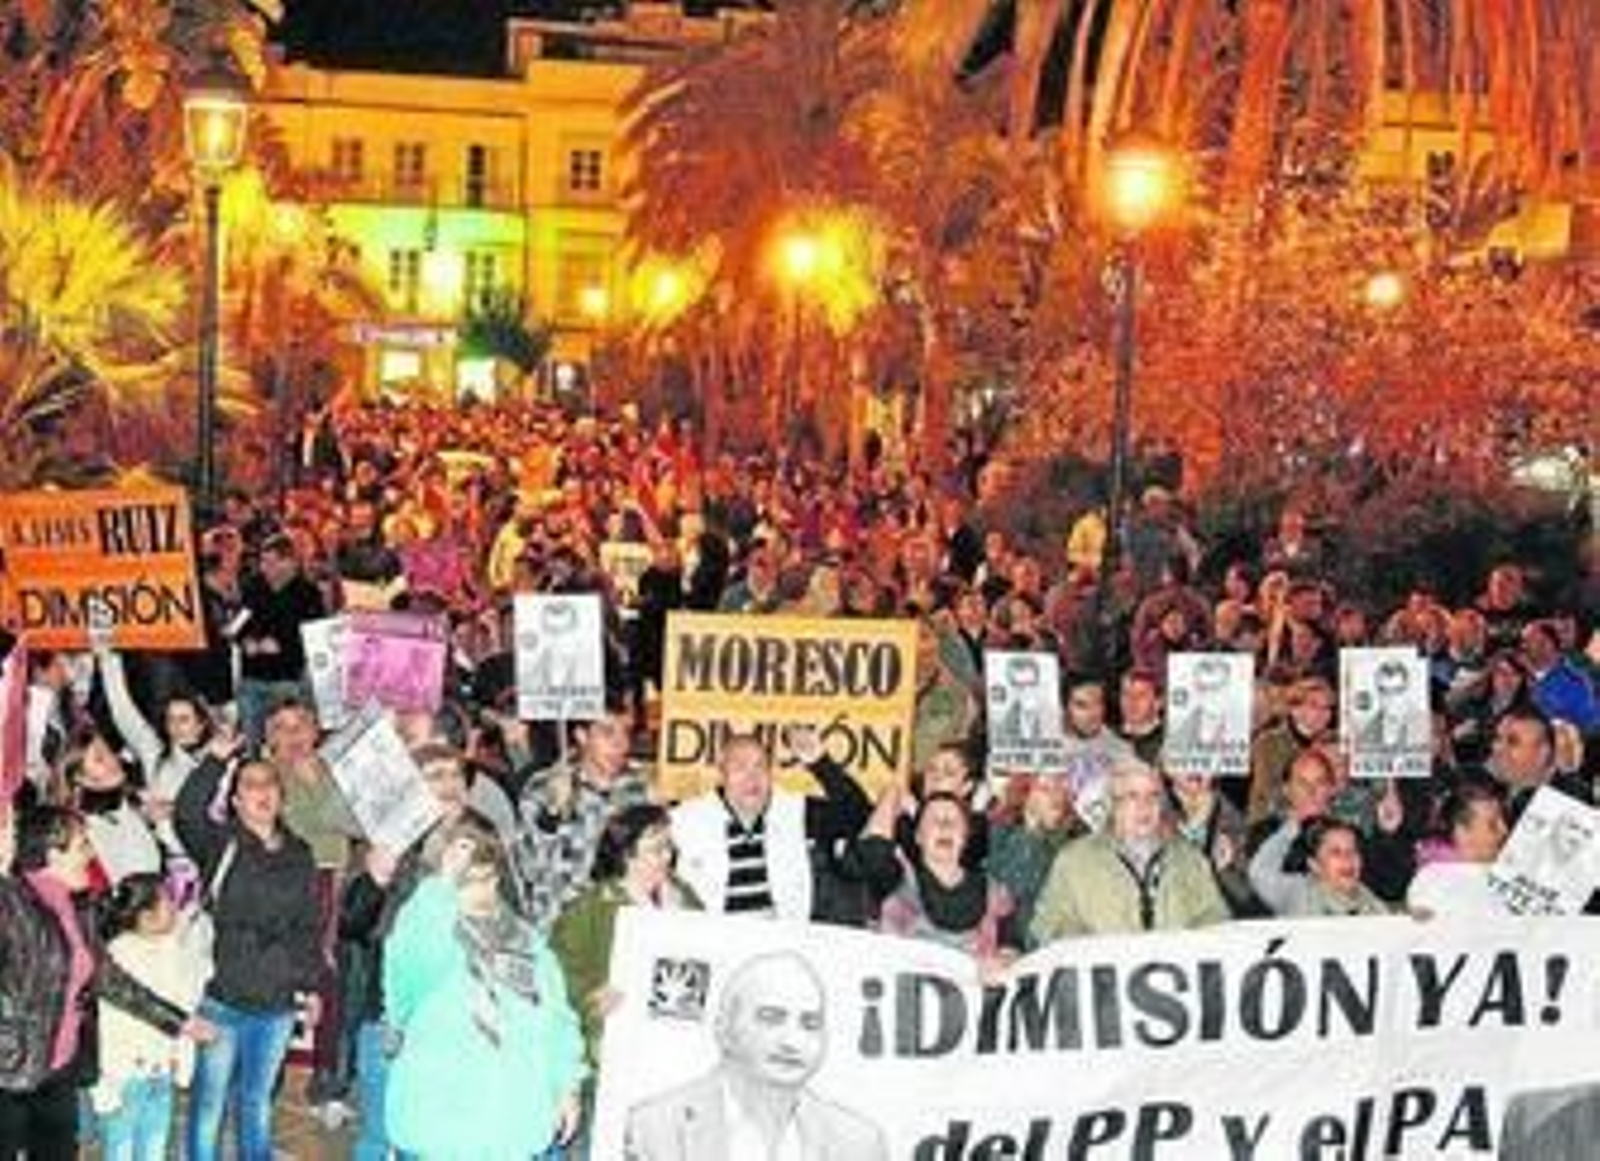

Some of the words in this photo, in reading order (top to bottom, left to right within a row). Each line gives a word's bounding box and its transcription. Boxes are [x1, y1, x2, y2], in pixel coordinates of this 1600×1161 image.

[97, 503, 184, 556] RUIZ
[675, 632, 902, 697] MORESCO
[858, 936, 1379, 1059] ¡DIMISIÓN
[1409, 949, 1569, 1028] YA!
[1067, 1100, 1193, 1161] PP
[1384, 1085, 1493, 1155] PA
